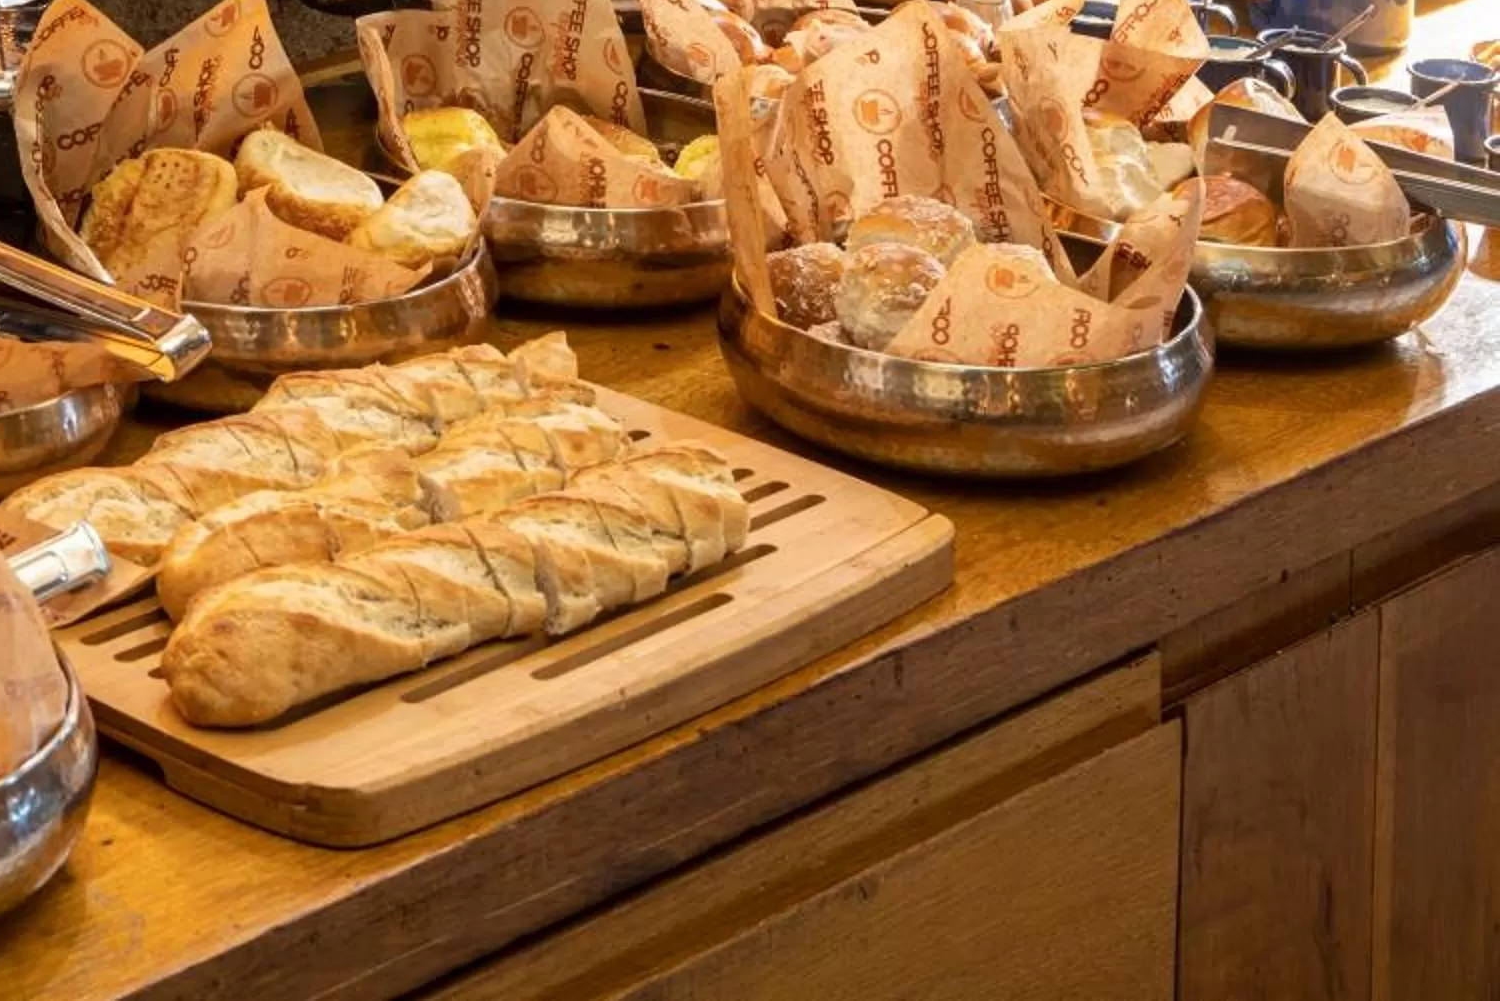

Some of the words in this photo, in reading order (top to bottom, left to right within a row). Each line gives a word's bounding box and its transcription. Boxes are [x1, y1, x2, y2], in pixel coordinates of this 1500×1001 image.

[466, 20, 482, 68] SHOP
[812, 110, 835, 167] SHOP
[981, 126, 1004, 208] COFFEE
